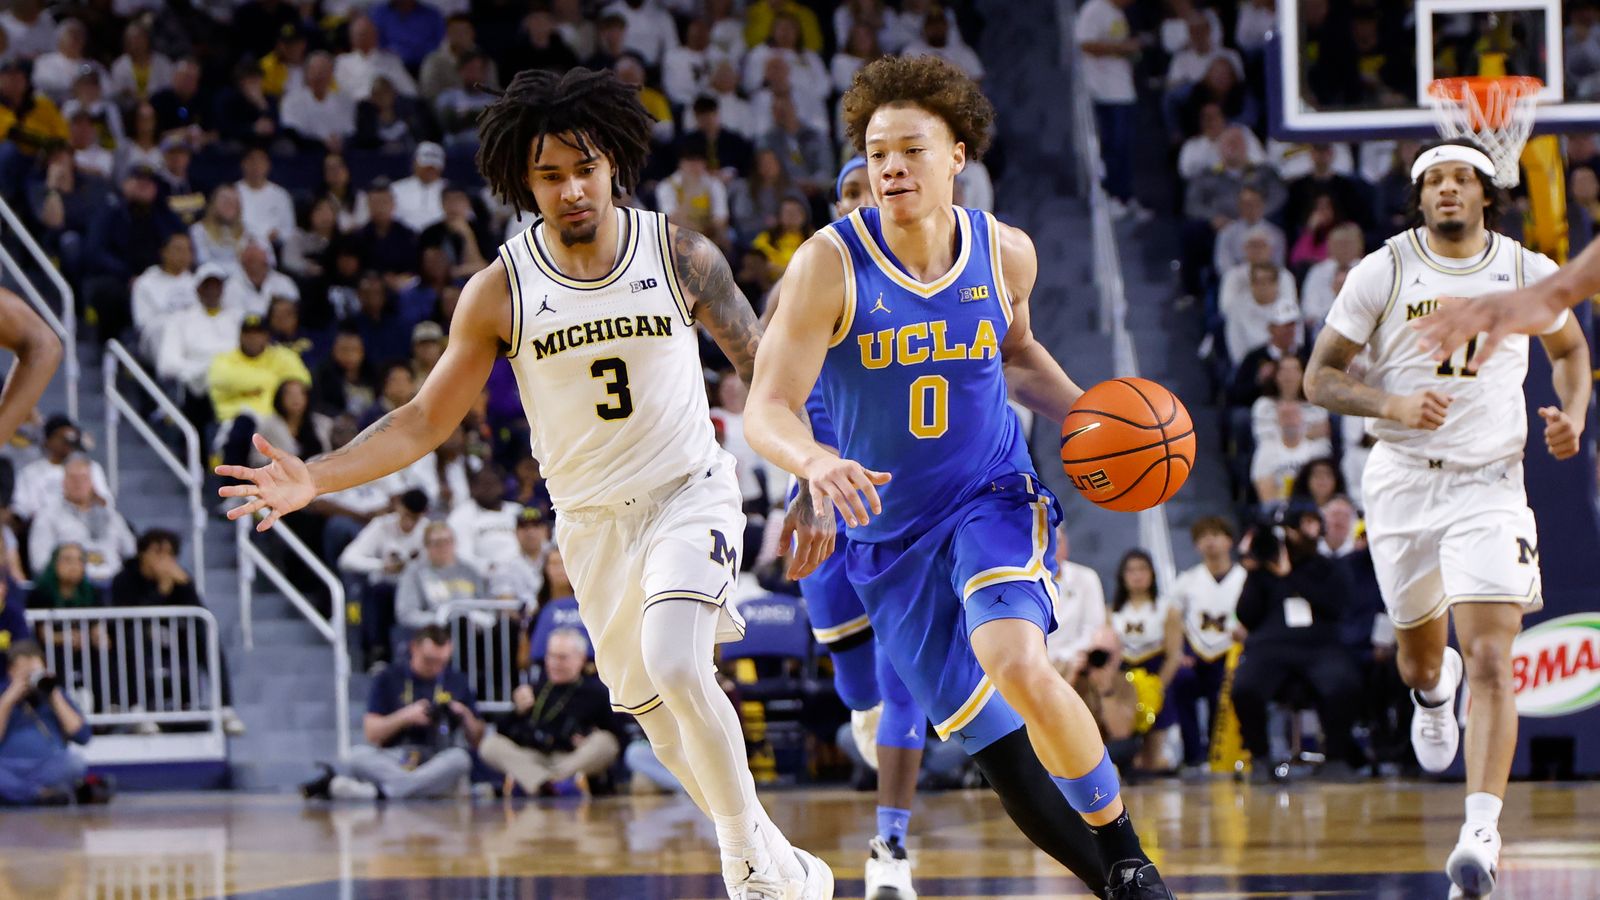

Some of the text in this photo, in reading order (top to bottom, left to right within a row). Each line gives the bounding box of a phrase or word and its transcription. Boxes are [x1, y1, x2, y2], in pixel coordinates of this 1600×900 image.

[532, 315, 673, 360] MICHIGAN
[857, 319, 998, 370] UCLA
[590, 357, 633, 421] 3
[908, 374, 949, 440] 0
[708, 528, 737, 582] M
[1516, 537, 1539, 564] M
